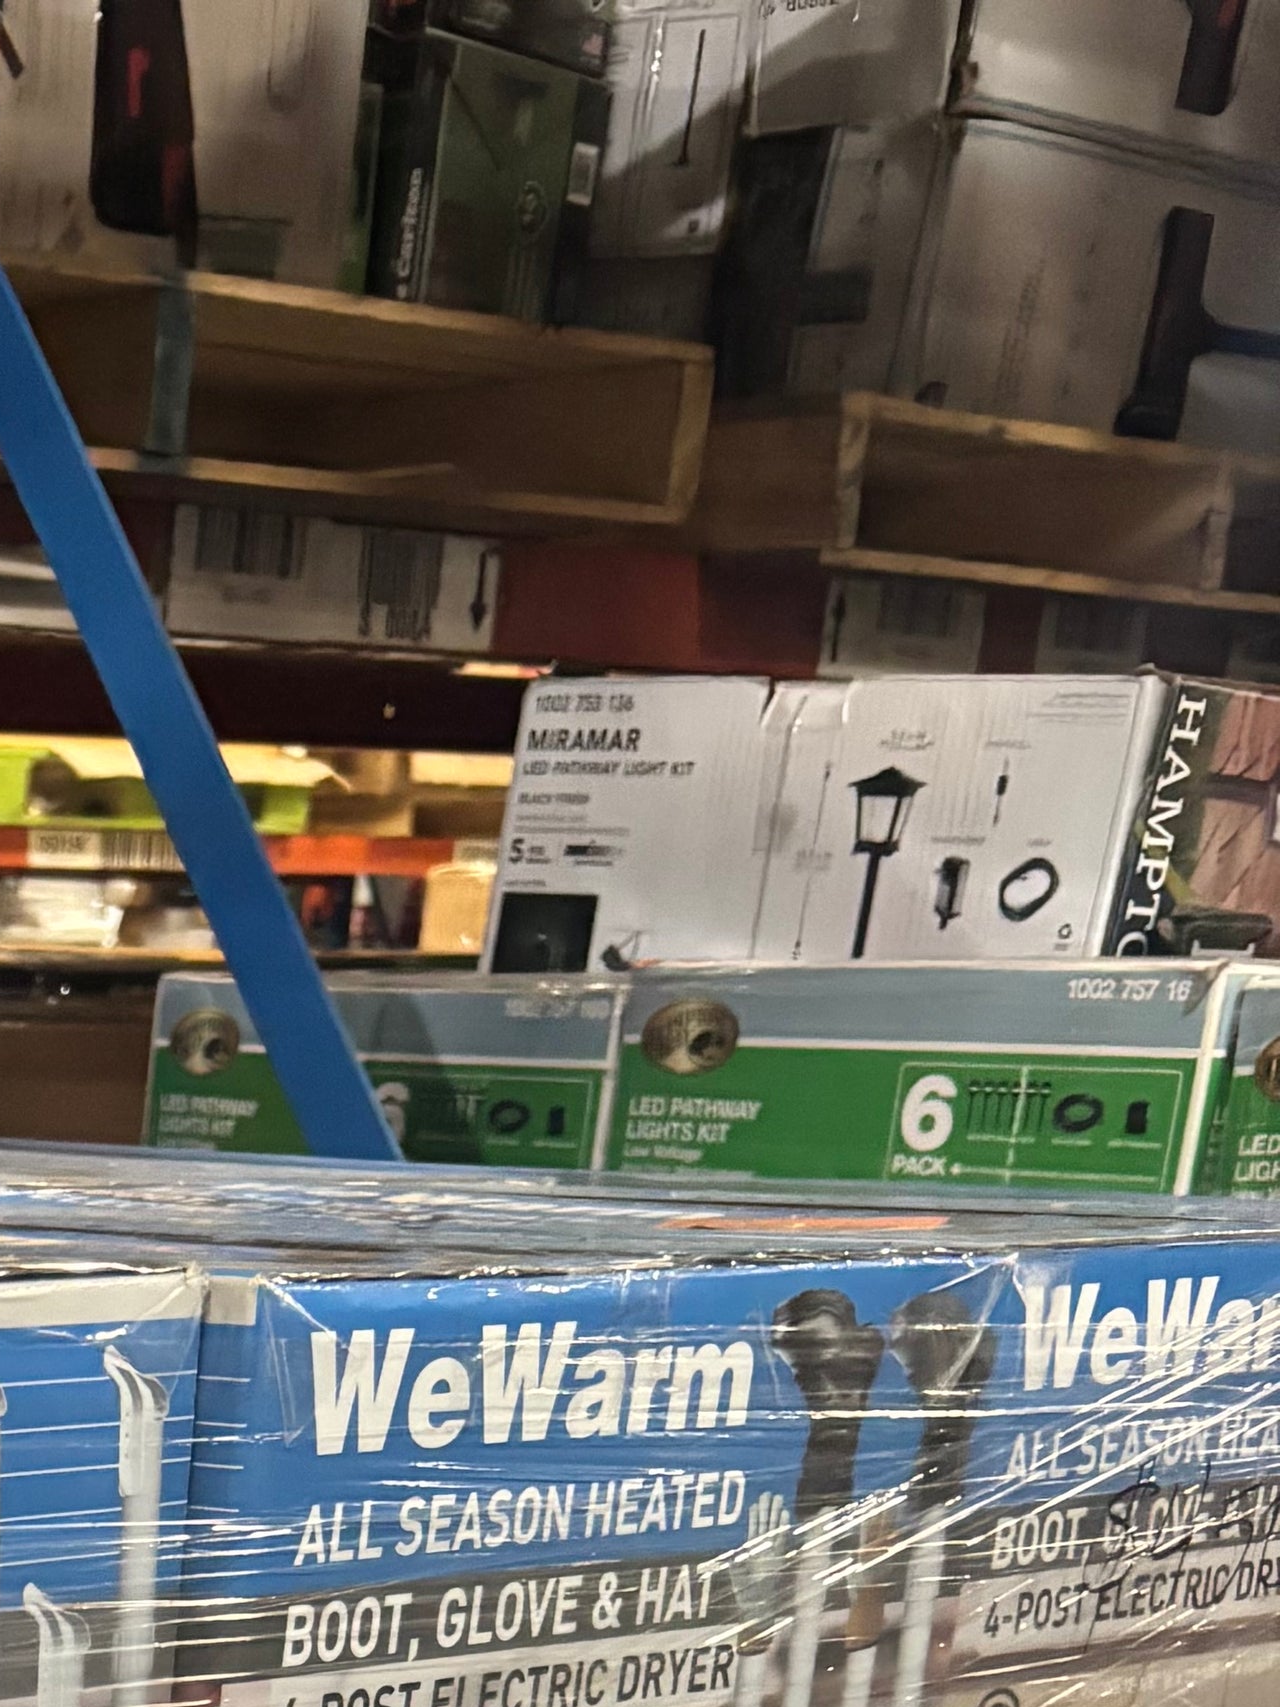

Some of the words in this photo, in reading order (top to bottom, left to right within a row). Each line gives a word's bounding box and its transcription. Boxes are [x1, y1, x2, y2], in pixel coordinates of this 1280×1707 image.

[527, 728, 642, 753] MIRAMAR
[1067, 980, 1117, 1000] 1002
[628, 1097, 666, 1118] LED
[669, 1098, 762, 1121] PATHWAY
[900, 1074, 958, 1152] 6
[625, 1121, 691, 1142] LIGHTS
[695, 1122, 731, 1143] KIT
[892, 1154, 946, 1177] PACK
[310, 1321, 755, 1456] WeWarm
[294, 1501, 384, 1567] ALL
[394, 1483, 573, 1558] SEASON
[585, 1470, 747, 1539] HEATED
[281, 1591, 421, 1667] BOOT,
[435, 1575, 584, 1649] GLOVE
[591, 1571, 621, 1631] &
[635, 1563, 727, 1626] HAT
[616, 1642, 735, 1701] DRYER
